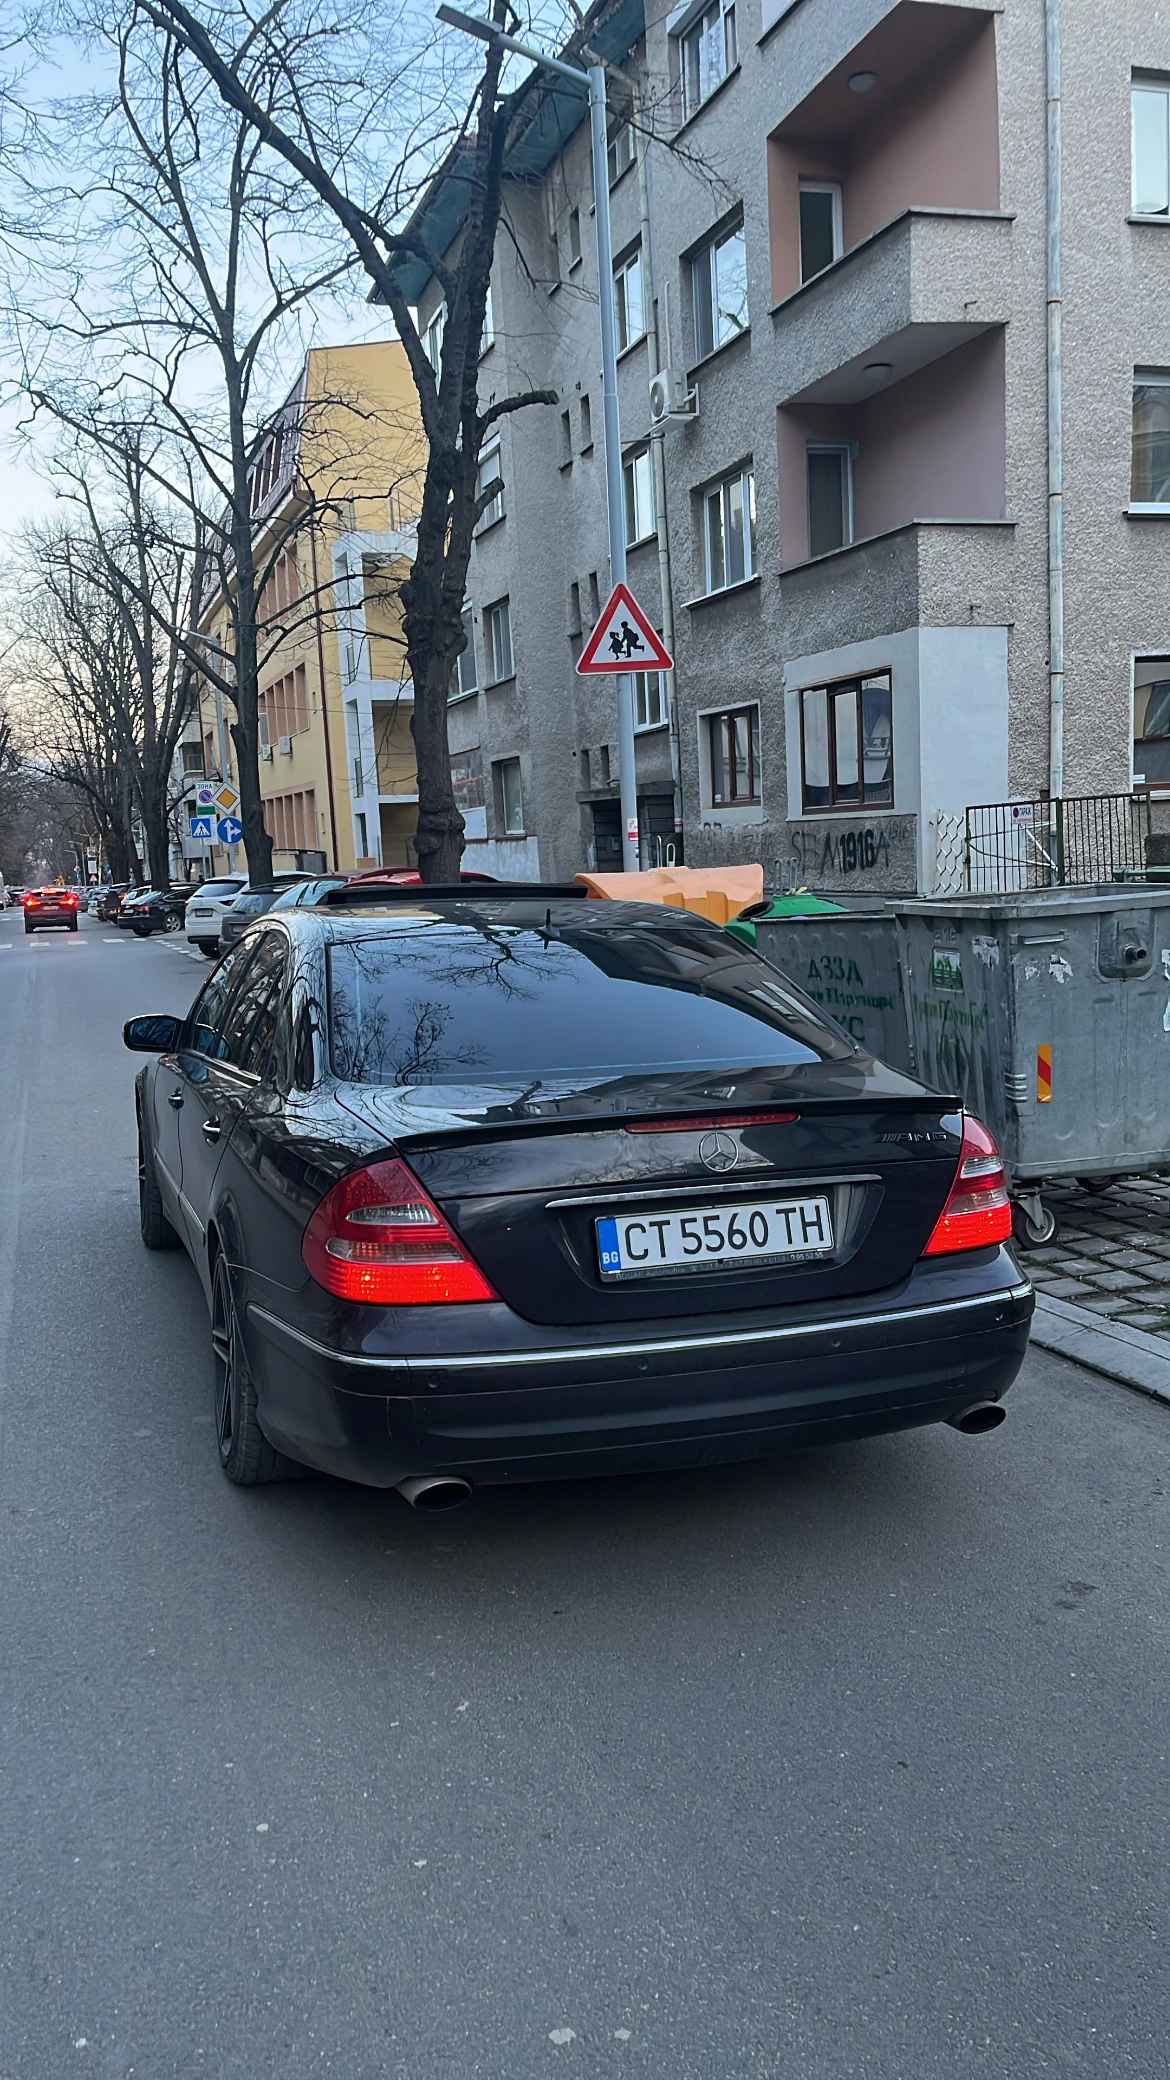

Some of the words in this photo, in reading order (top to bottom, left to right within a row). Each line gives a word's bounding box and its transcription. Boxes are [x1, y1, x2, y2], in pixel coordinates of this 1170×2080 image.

[895, 1132, 947, 1142] AMG
[624, 1219, 671, 1261] CT
[680, 1210, 769, 1255] 5560
[775, 1204, 825, 1245] TH
[602, 1251, 619, 1265] BG
